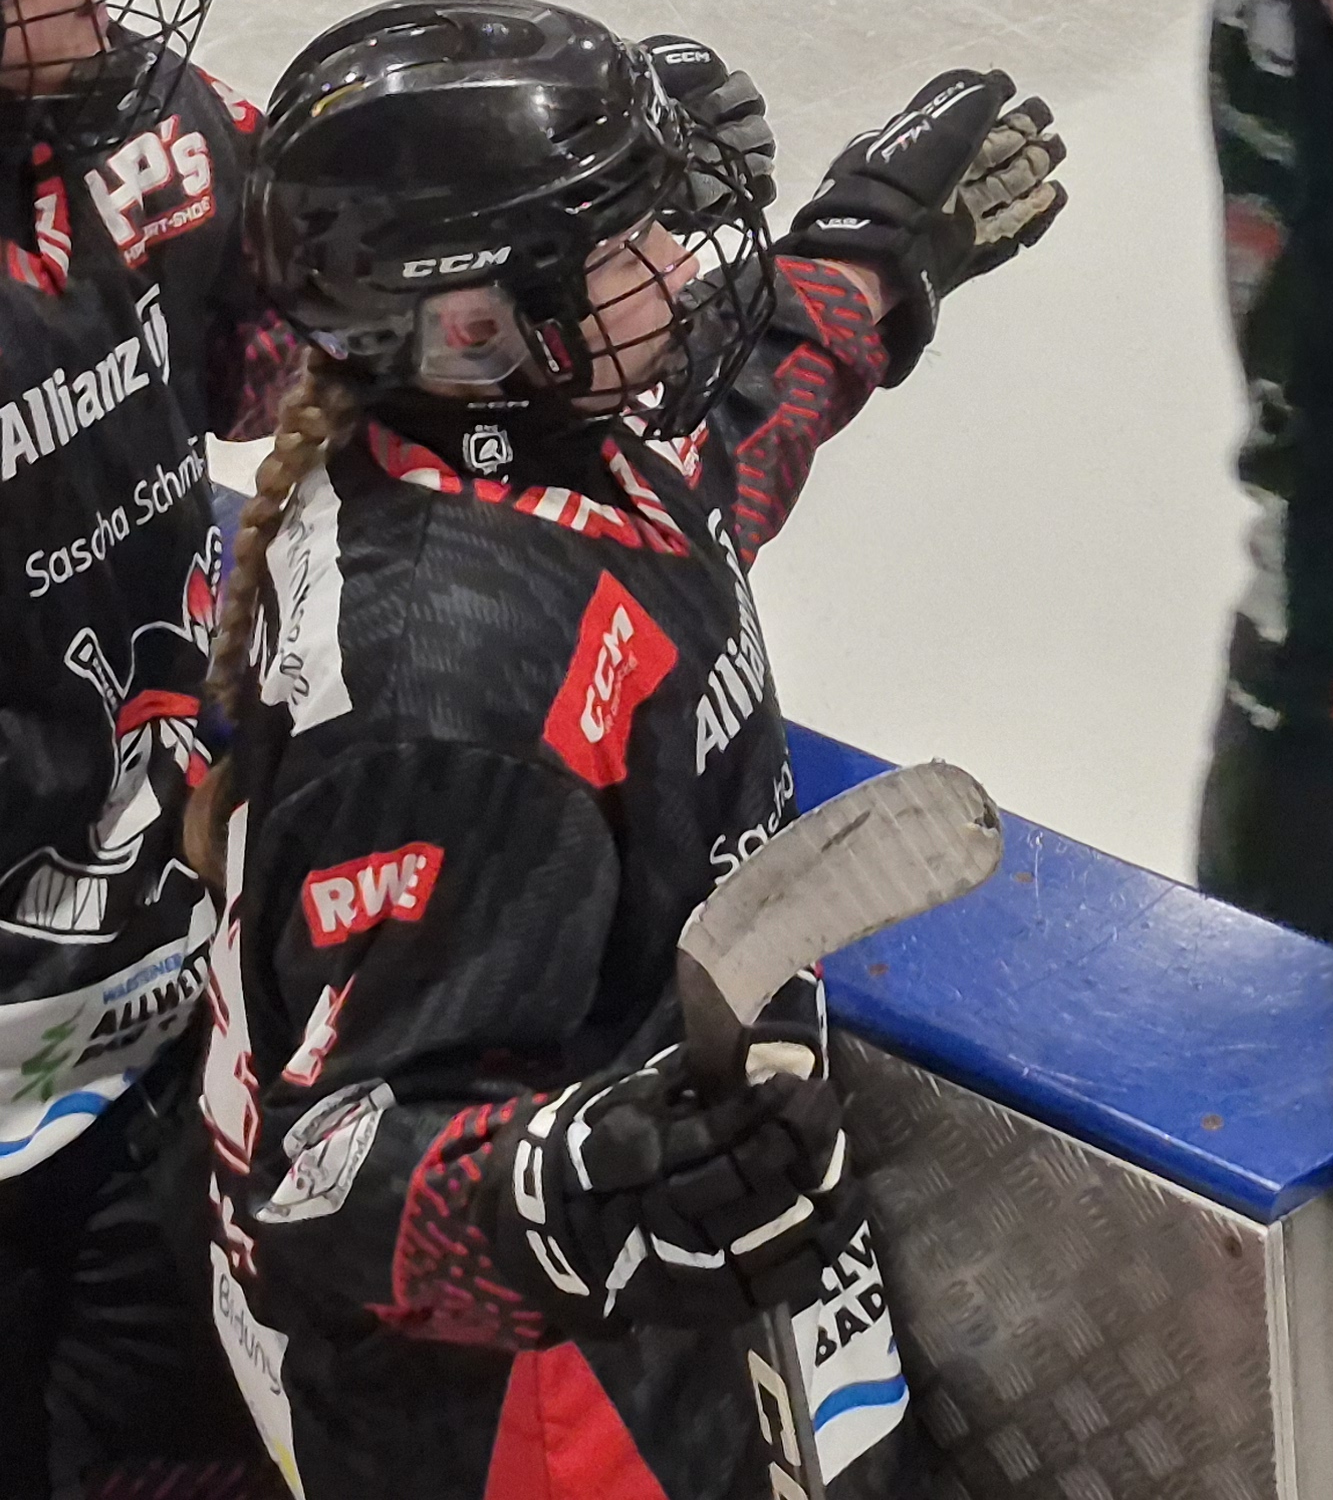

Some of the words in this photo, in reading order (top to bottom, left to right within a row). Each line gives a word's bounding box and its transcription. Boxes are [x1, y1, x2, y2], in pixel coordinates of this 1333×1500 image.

[665, 51, 711, 65] CCM
[403, 246, 512, 279] CCM
[0, 337, 150, 482] Allianz
[25, 505, 129, 599] Sascha
[581, 604, 635, 744] CCM
